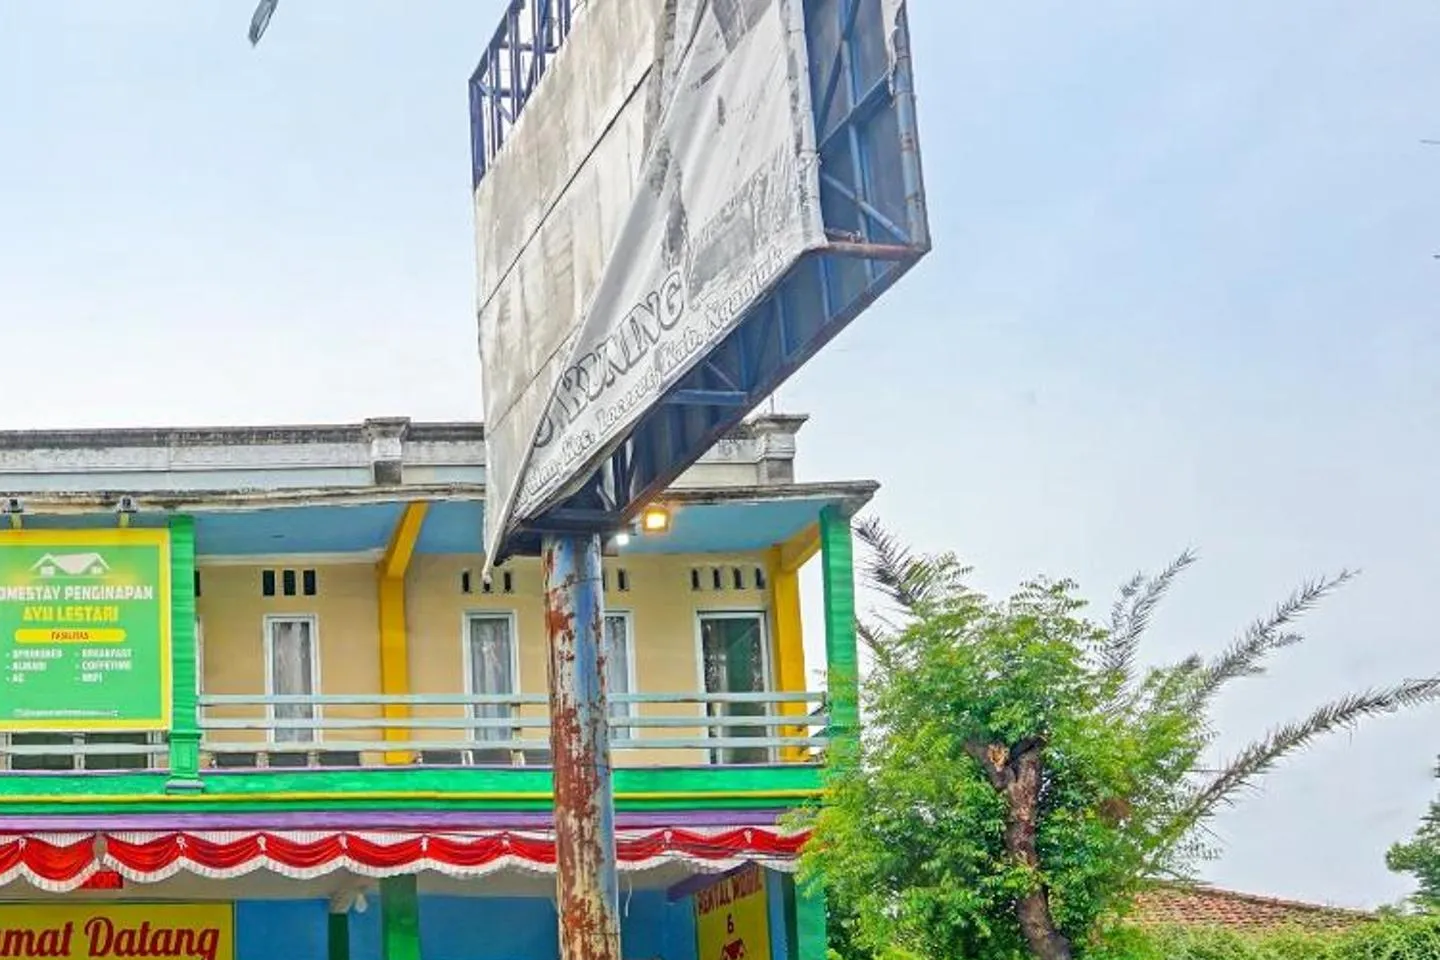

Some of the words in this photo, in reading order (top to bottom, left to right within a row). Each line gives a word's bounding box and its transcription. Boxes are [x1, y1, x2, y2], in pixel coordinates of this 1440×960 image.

[706, 245, 785, 332] Nganjuk
[64, 585, 153, 600] PENGINAPAN
[23, 606, 53, 622] AYU
[57, 606, 118, 622] LESTARI
